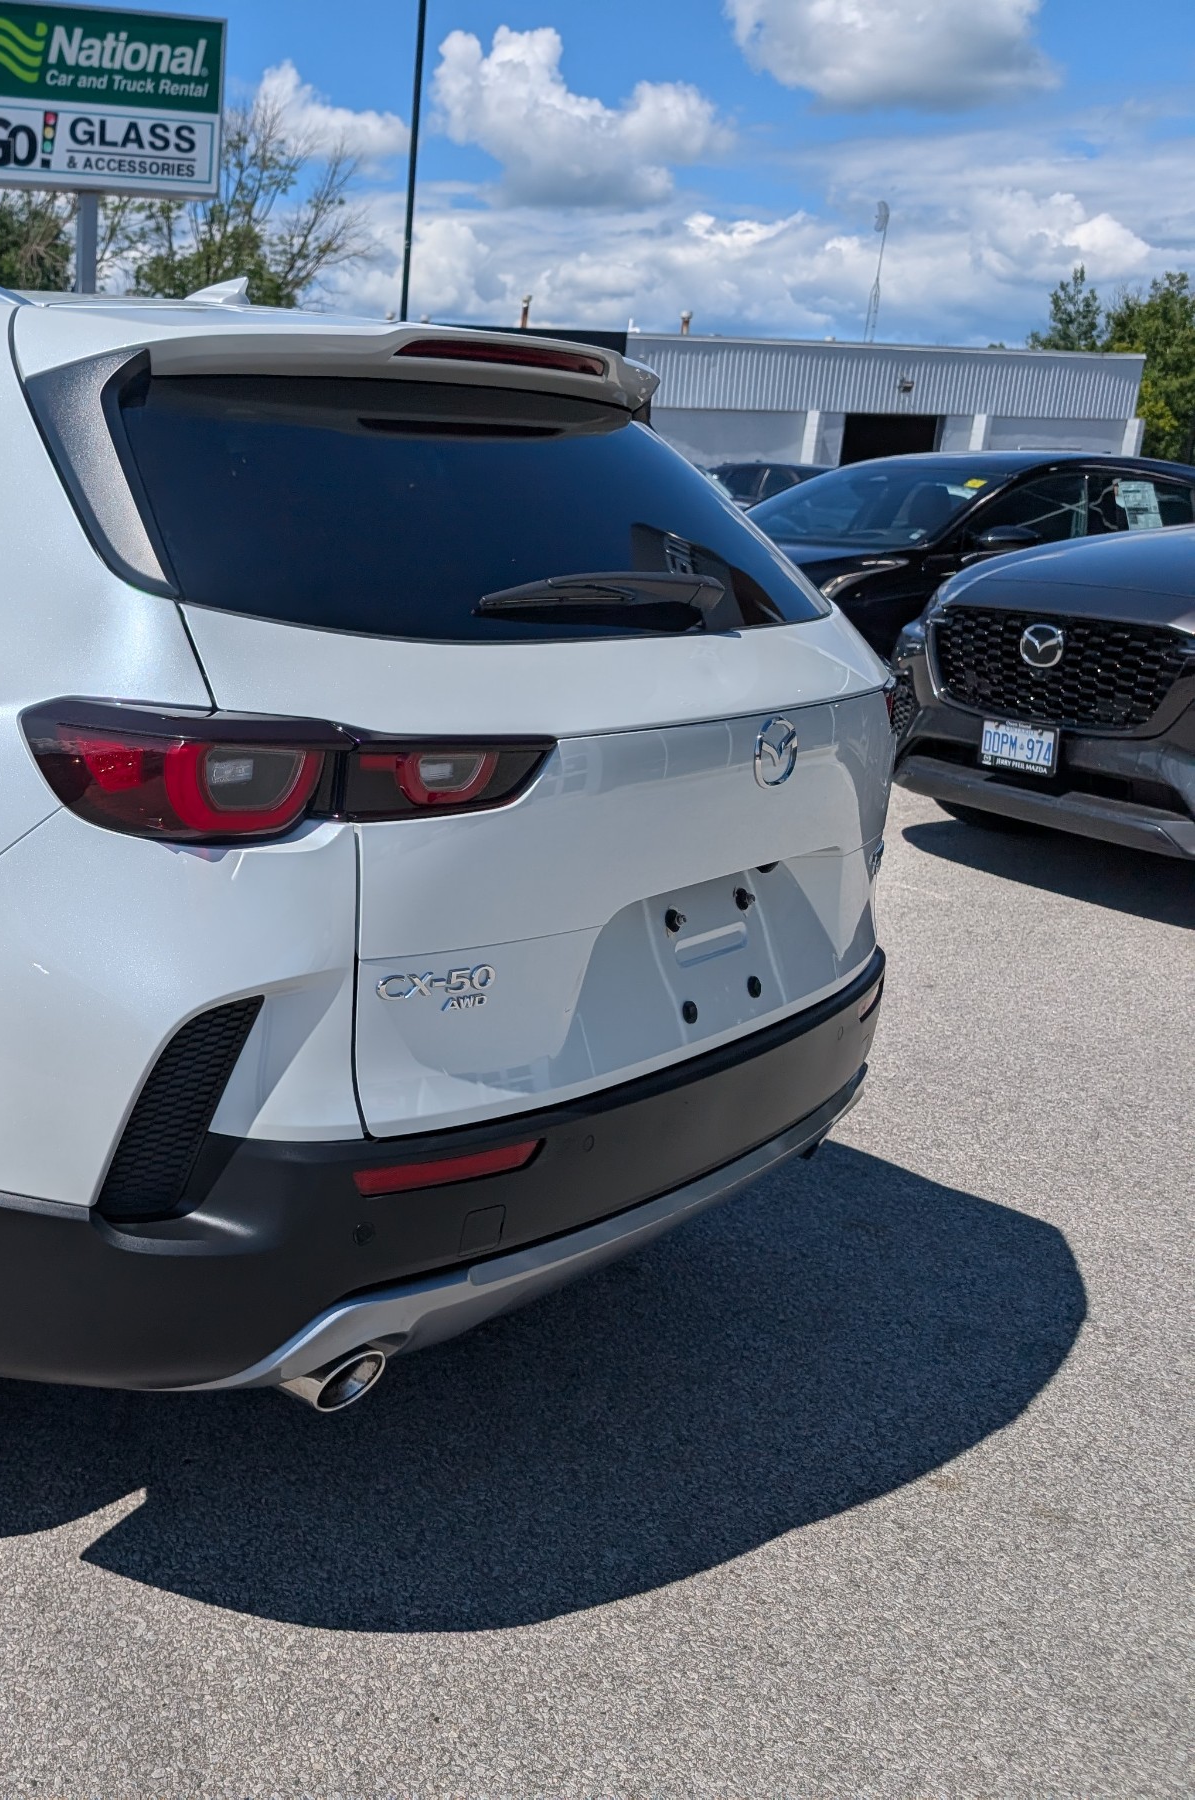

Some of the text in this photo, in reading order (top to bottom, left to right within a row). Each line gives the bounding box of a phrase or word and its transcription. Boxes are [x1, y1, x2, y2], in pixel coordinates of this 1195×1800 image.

[47, 25, 208, 77] National
[45, 70, 209, 98] Car and Truck Rental
[69, 117, 197, 153] GLASS
[67, 156, 196, 178] & ACCESSORIES
[983, 730, 1052, 764] DDPM 974
[1025, 764, 1048, 774] MAZDA
[376, 963, 496, 1000] CX-50
[441, 993, 488, 1011] AWD
